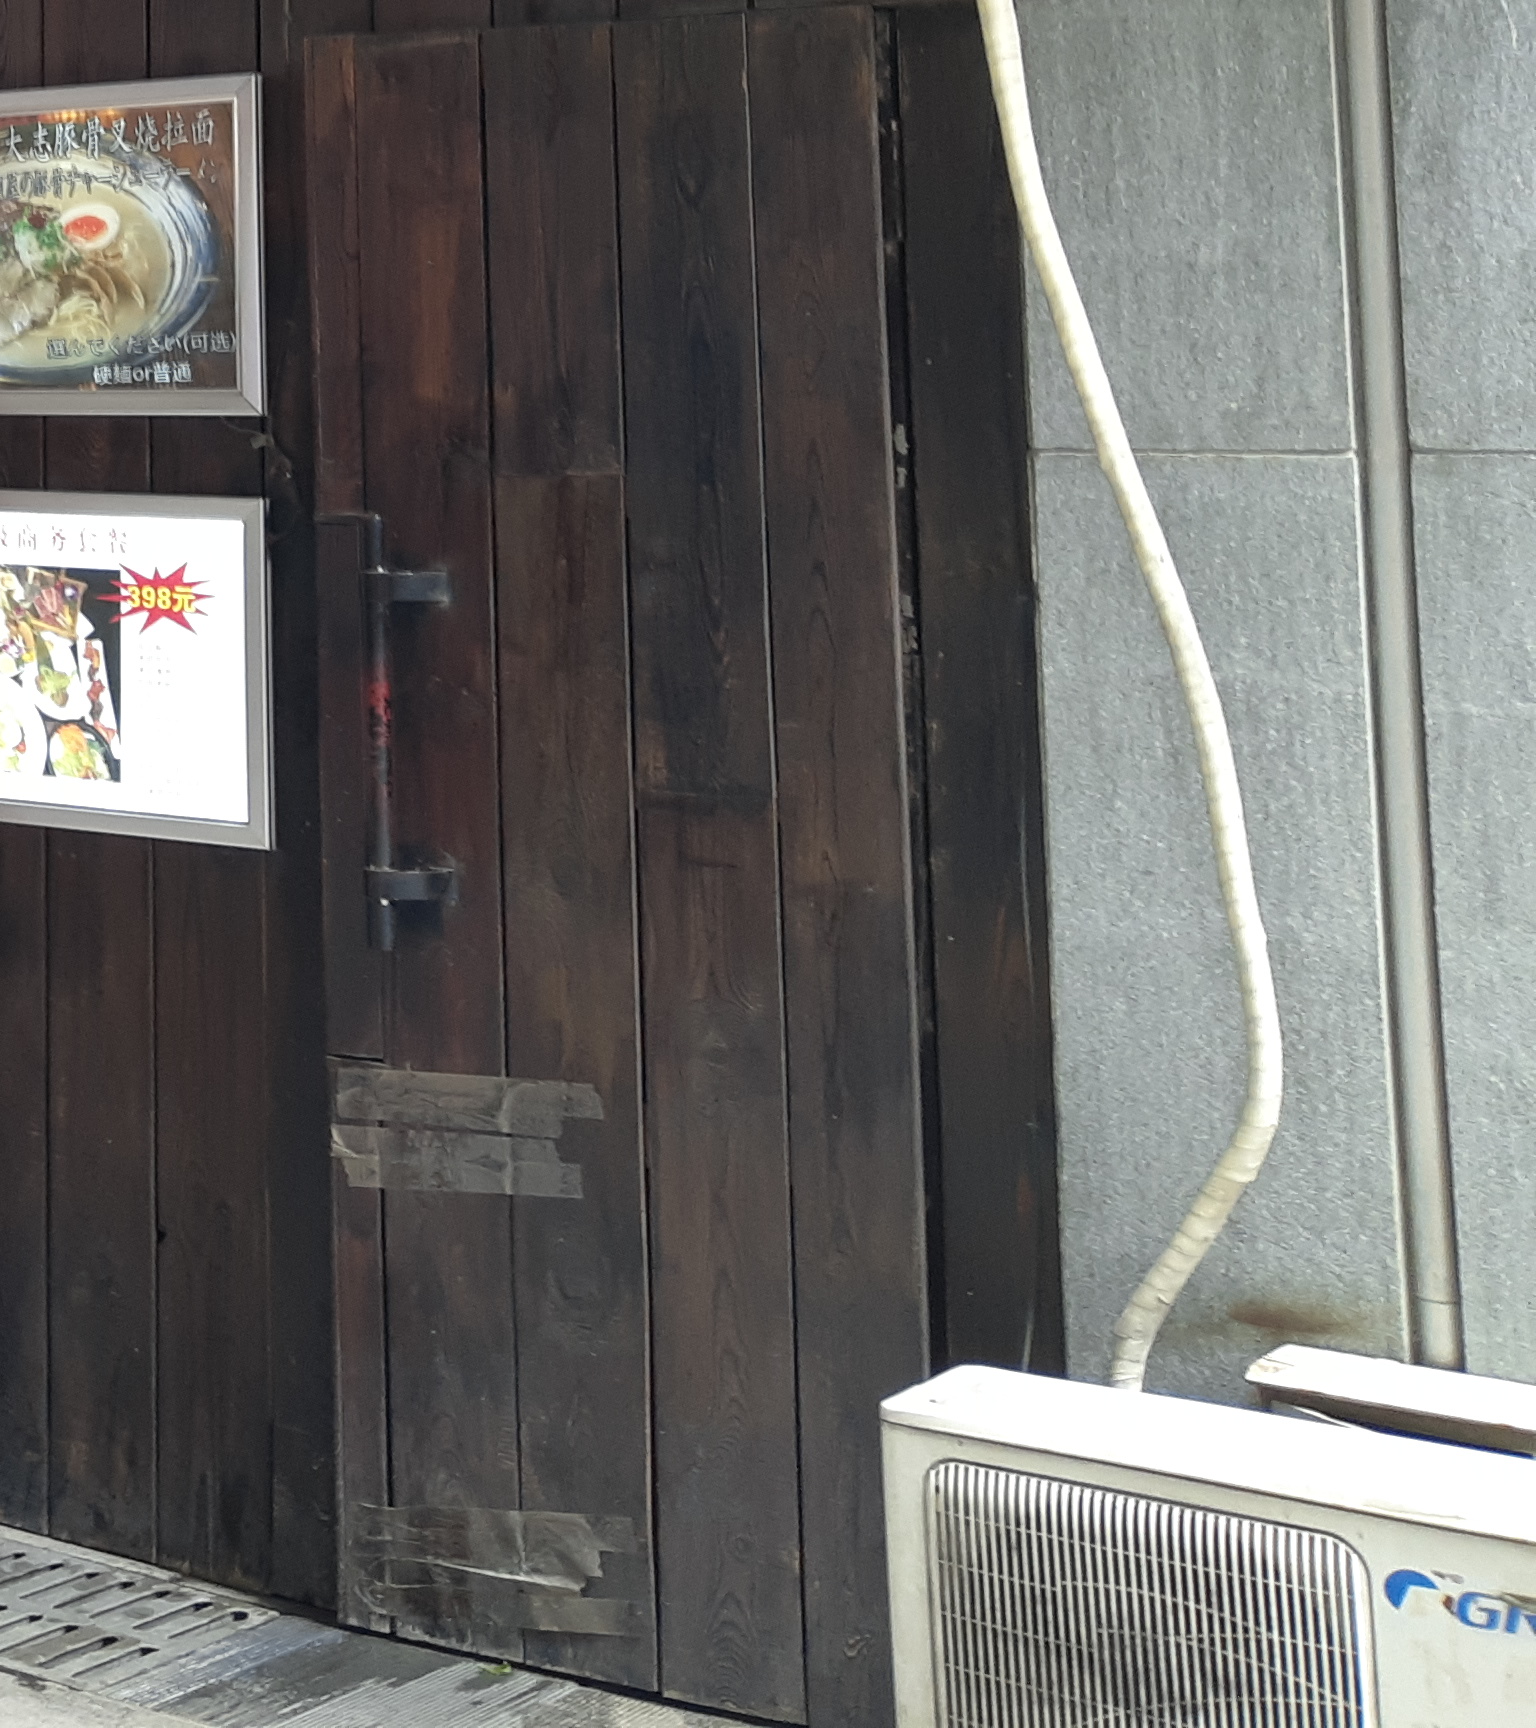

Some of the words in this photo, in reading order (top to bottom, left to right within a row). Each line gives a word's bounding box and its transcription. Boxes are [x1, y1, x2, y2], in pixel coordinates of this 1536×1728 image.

[6, 108, 215, 162] 大志豚骨叉烧拉面
[126, 584, 197, 614] 398元
